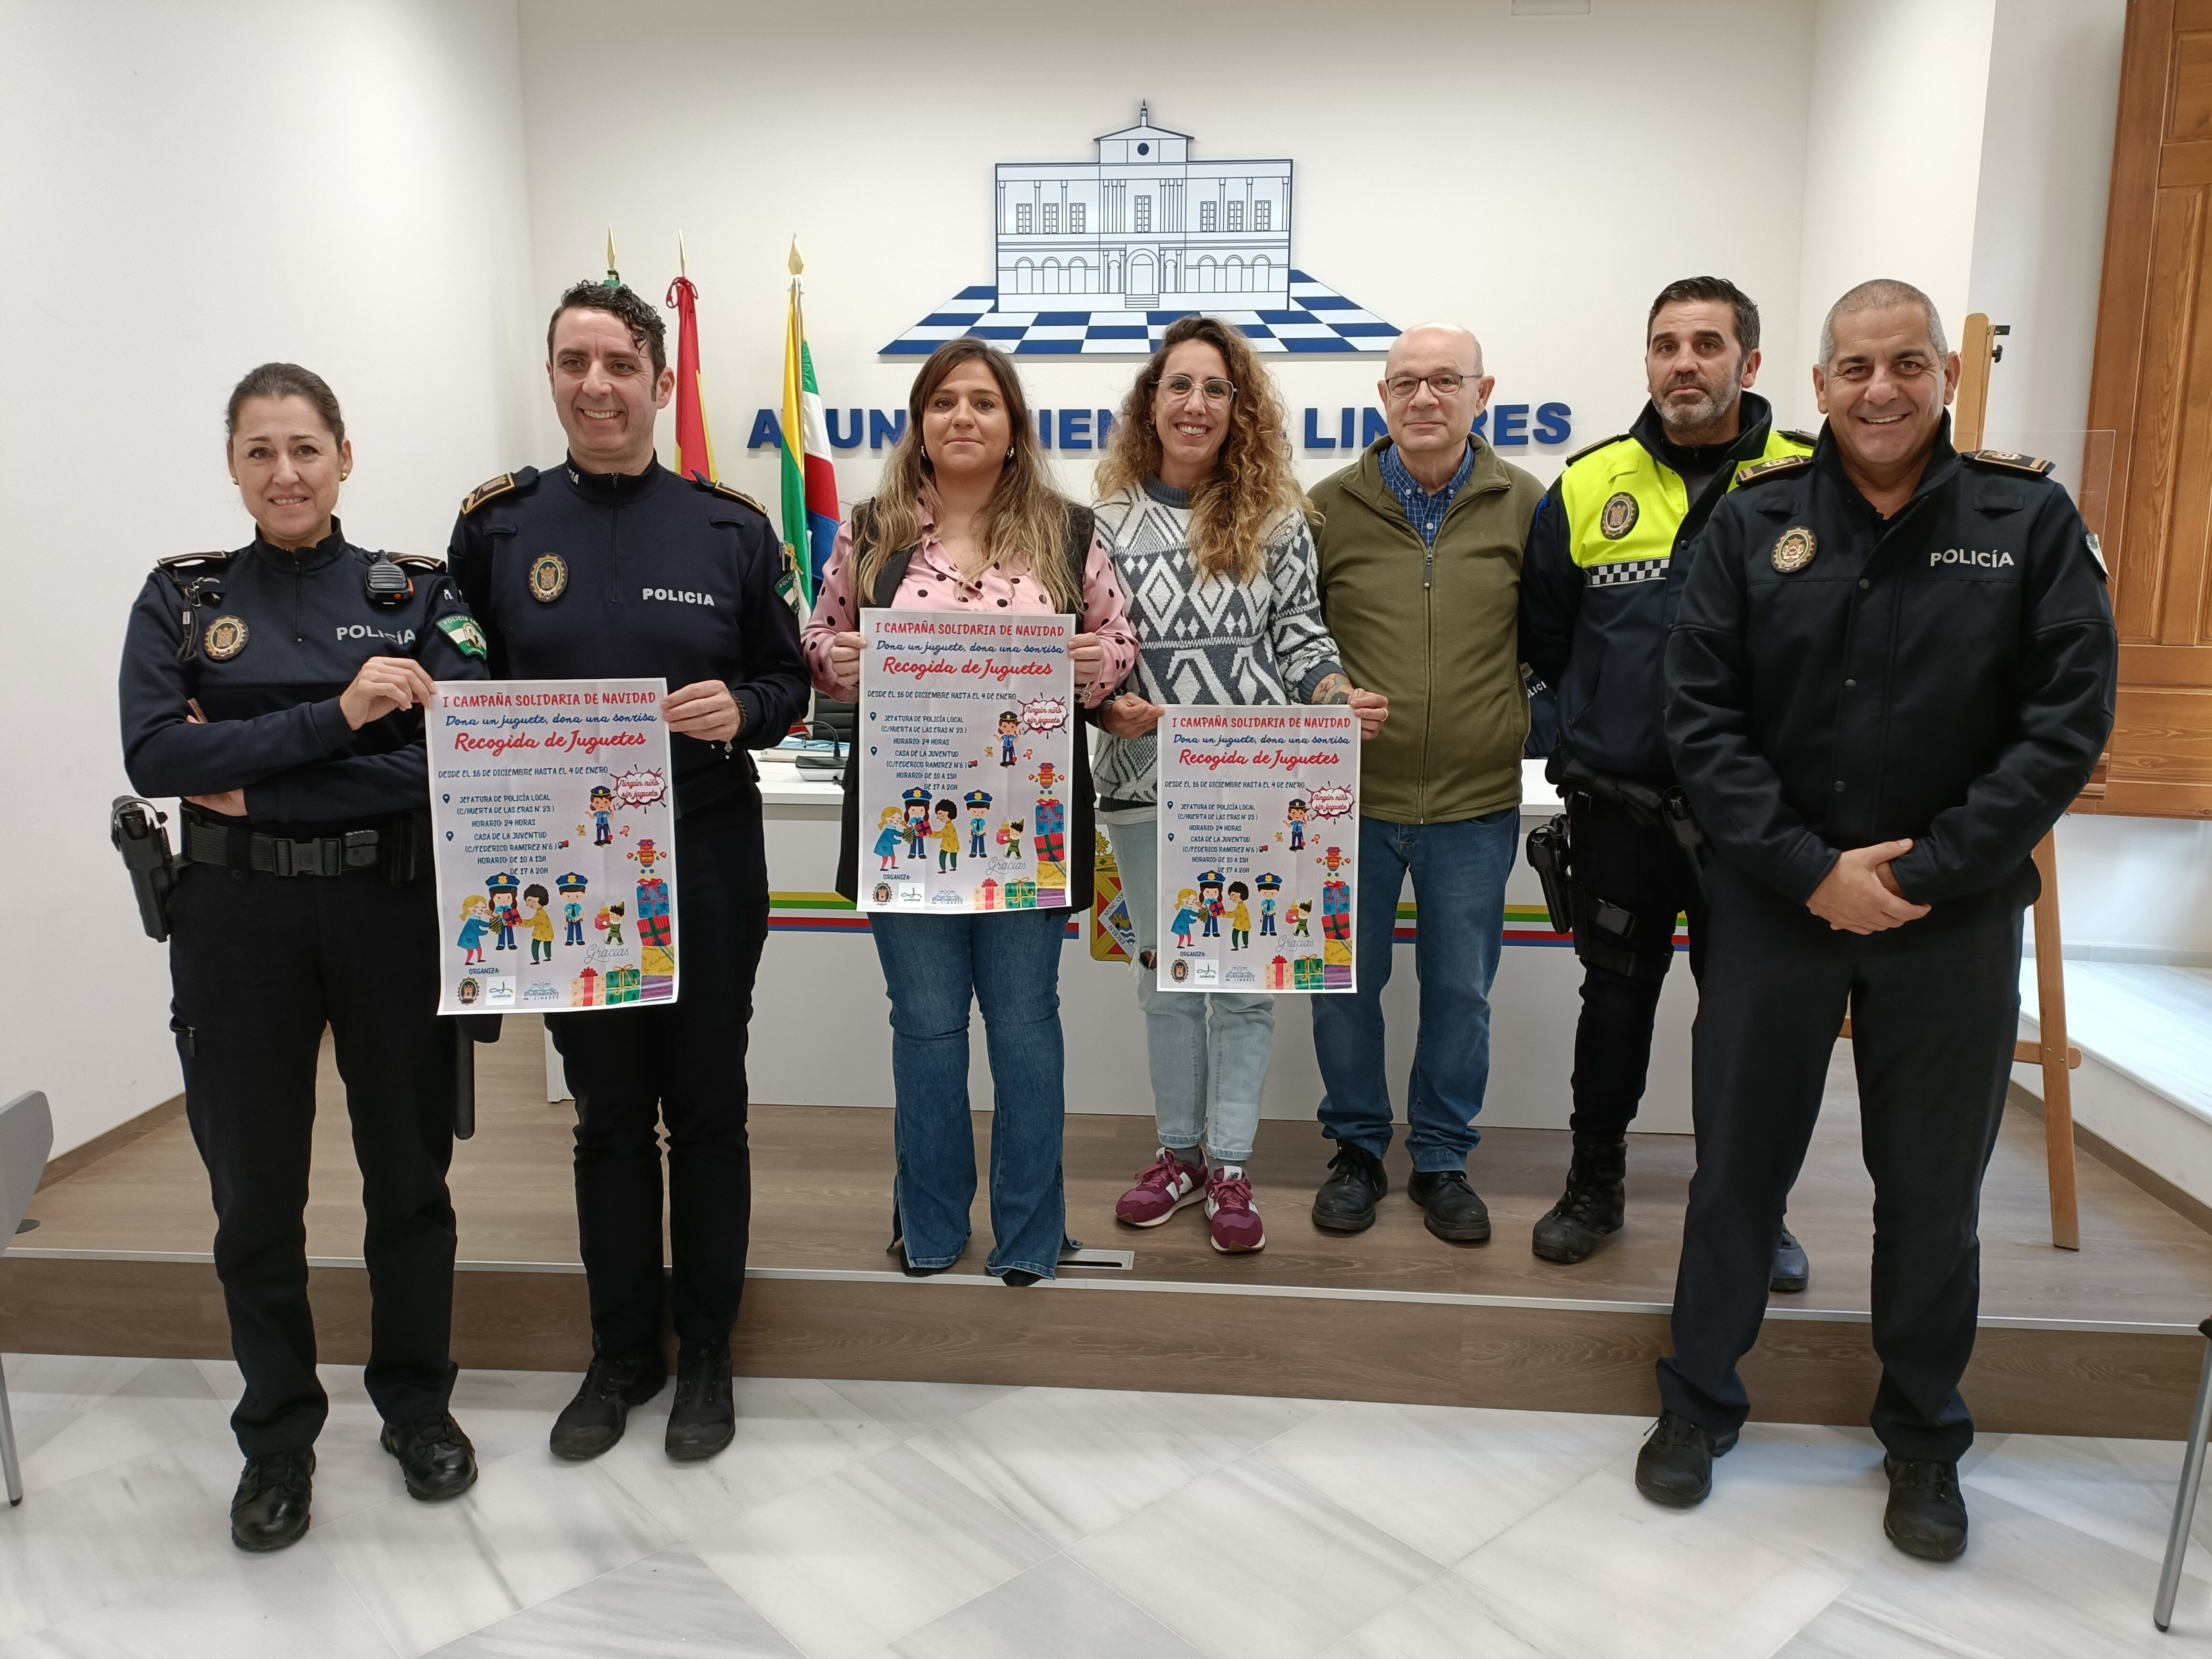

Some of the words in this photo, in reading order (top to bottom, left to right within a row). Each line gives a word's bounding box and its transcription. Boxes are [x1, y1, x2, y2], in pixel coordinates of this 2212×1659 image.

[1930, 549, 2014, 567] POLICÍA
[642, 588, 715, 606] POLICIA
[443, 616, 469, 625] POLICIA
[876, 622, 881, 633] I
[885, 620, 935, 634] CAMPAÑA
[938, 624, 996, 635] SOLIDARIA
[999, 625, 1012, 636] DE
[1016, 625, 1064, 637] NAVIDAD
[336, 625, 416, 645] POLICÍA
[877, 641, 906, 651] Dona
[920, 641, 966, 655] juguete,
[969, 642, 997, 653] dona
[1023, 645, 1065, 653] sonrisa
[883, 656, 957, 680] Recogida
[961, 658, 982, 674] de
[978, 658, 1053, 682] Juguetes
[443, 697, 450, 708] I
[454, 692, 512, 708] CAMPAÑA
[516, 694, 580, 706] SOLIDARIA
[584, 693, 599, 705] DE
[602, 692, 655, 705] NAVIDAD
[446, 716, 479, 726] Dona
[496, 714, 548, 730] juguete,
[552, 713, 584, 723] dona
[611, 713, 657, 722] sonrisa
[923, 714, 945, 722] POLICÍA
[1172, 718, 1177, 727] I
[1181, 715, 1228, 728] CAMPAÑA
[1231, 718, 1285, 728] SOLIDARIA
[1289, 718, 1301, 728] DE
[1304, 718, 1351, 728] NAVIDAD
[454, 731, 540, 757] Recogida
[544, 731, 567, 747] de
[563, 729, 647, 755] Juguetes
[1173, 734, 1200, 743] Dona
[1214, 735, 1257, 747] juguete,
[1260, 734, 1286, 743] dona
[1312, 736, 1351, 744] sonrisa
[1179, 749, 1249, 770] Recogida
[1252, 750, 1272, 764] de
[1268, 750, 1340, 771] Juguetes
[438, 770, 460, 778] DESDE
[493, 768, 533, 777] DICIEMBRE
[459, 796, 492, 804] JEFATURA
[504, 793, 530, 802] POLICÍA
[457, 807, 493, 815] (C/HUERTA
[465, 845, 508, 853] (C/FEDERICO
[986, 857, 1026, 875] Gracias
[1104, 902, 1117, 916] NUNC
[1276, 935, 1314, 952] Gracias
[584, 941, 629, 964] Gracias
